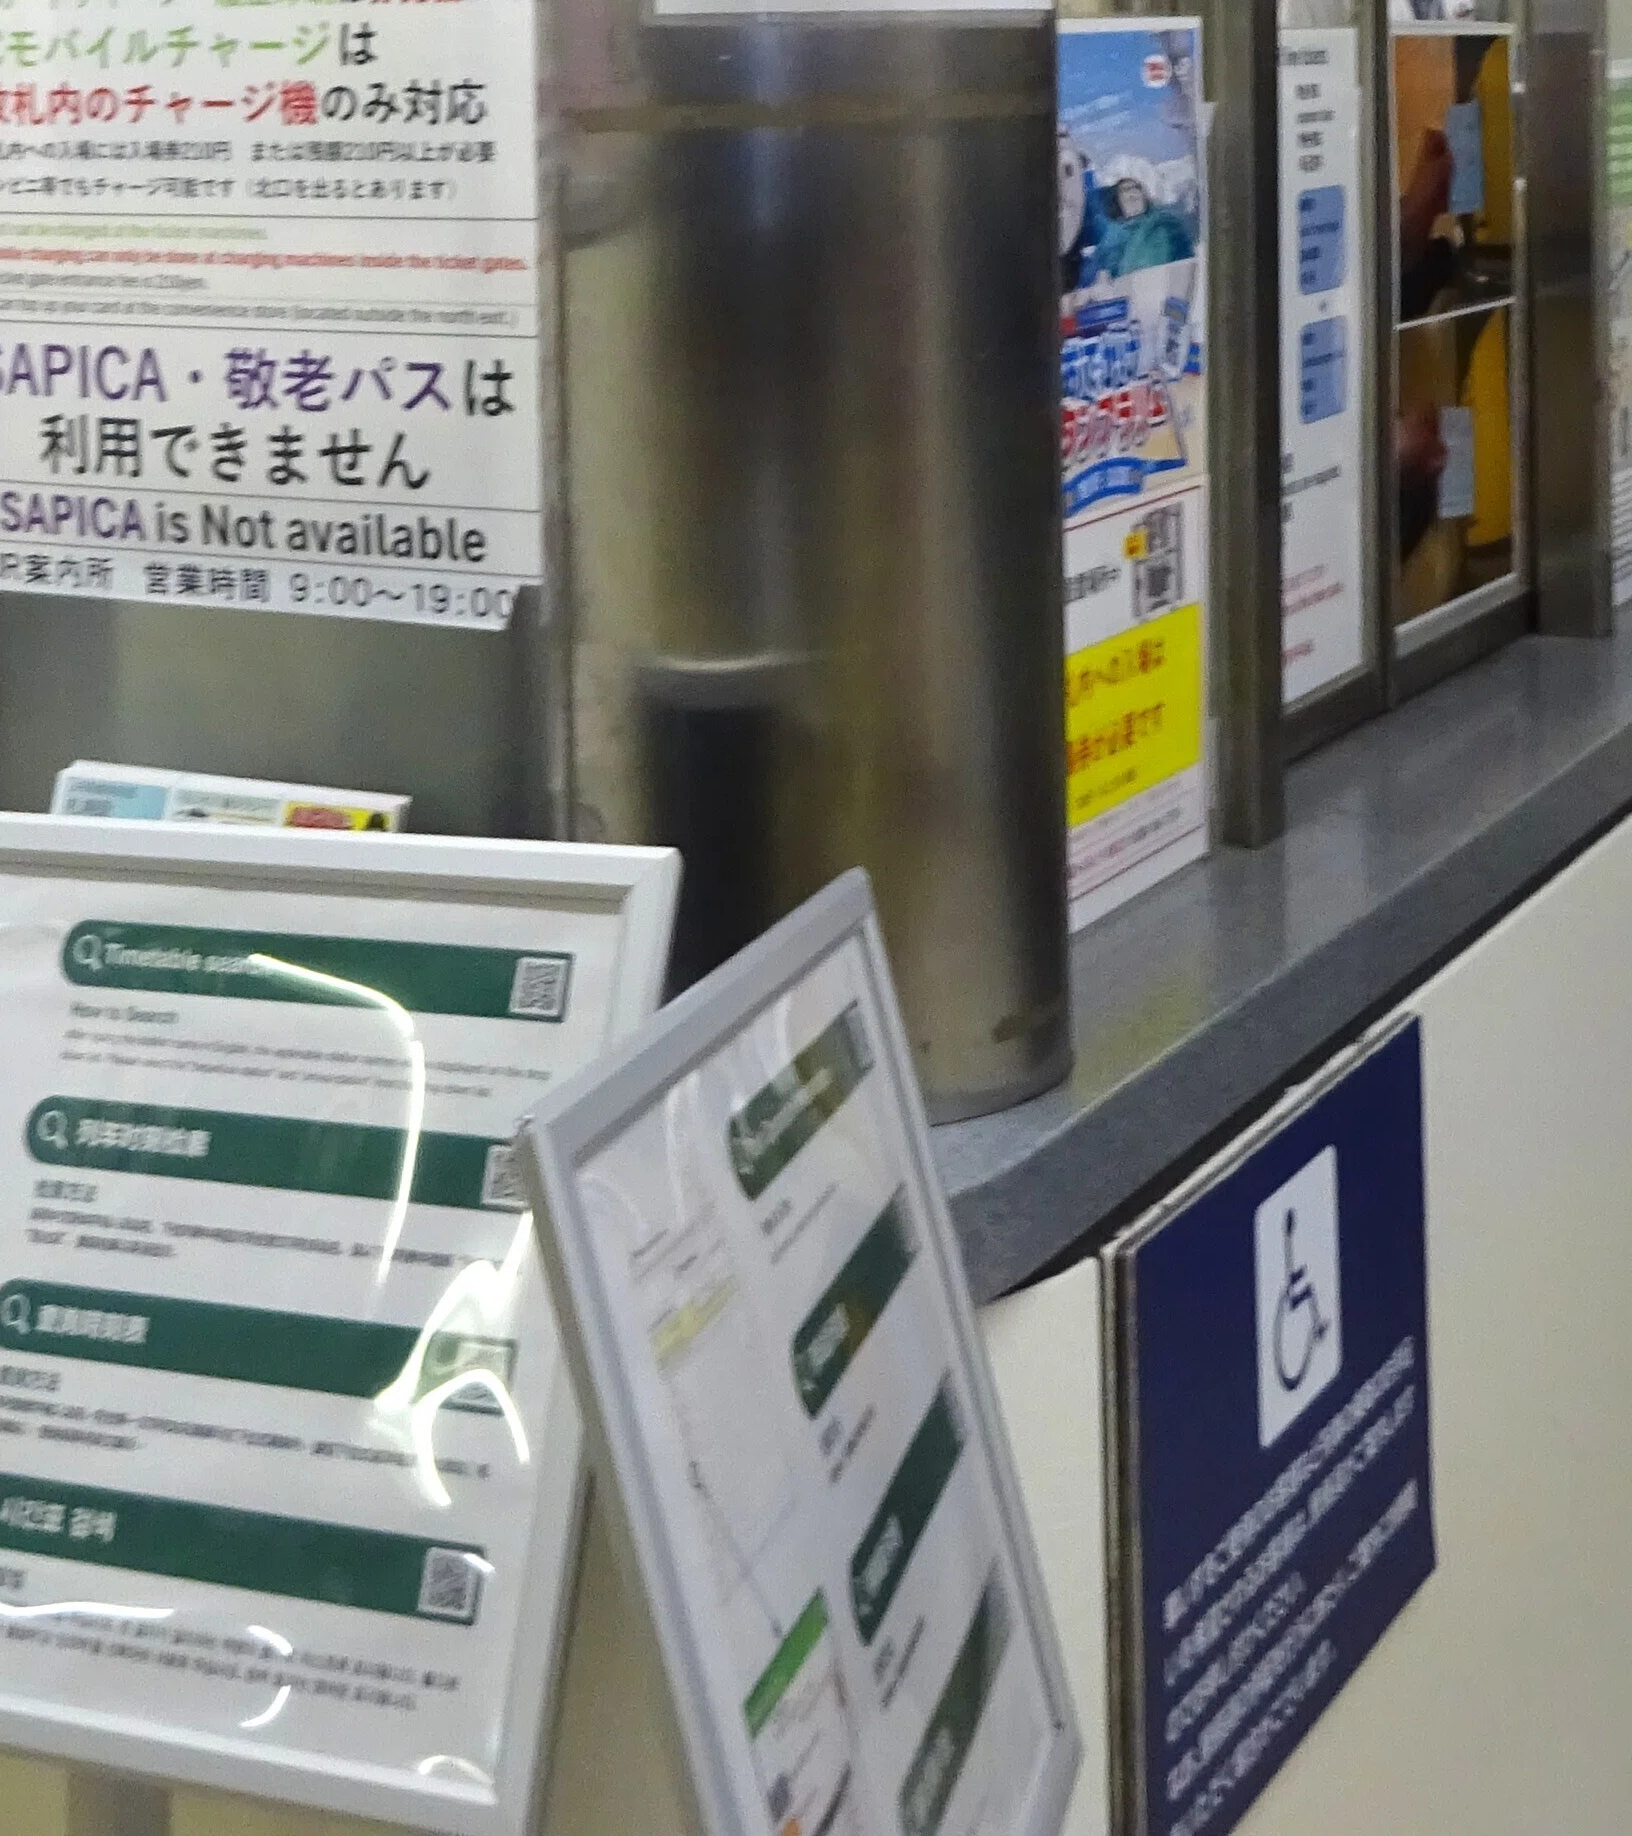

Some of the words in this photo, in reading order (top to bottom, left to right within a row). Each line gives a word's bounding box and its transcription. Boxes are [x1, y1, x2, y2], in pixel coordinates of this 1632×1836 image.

[39, 414, 430, 490] 利用できません
[0, 490, 147, 541] SAPICA
[155, 502, 190, 546] is
[201, 504, 275, 549] Not
[288, 512, 487, 563] available
[144, 563, 271, 604] 営業時間
